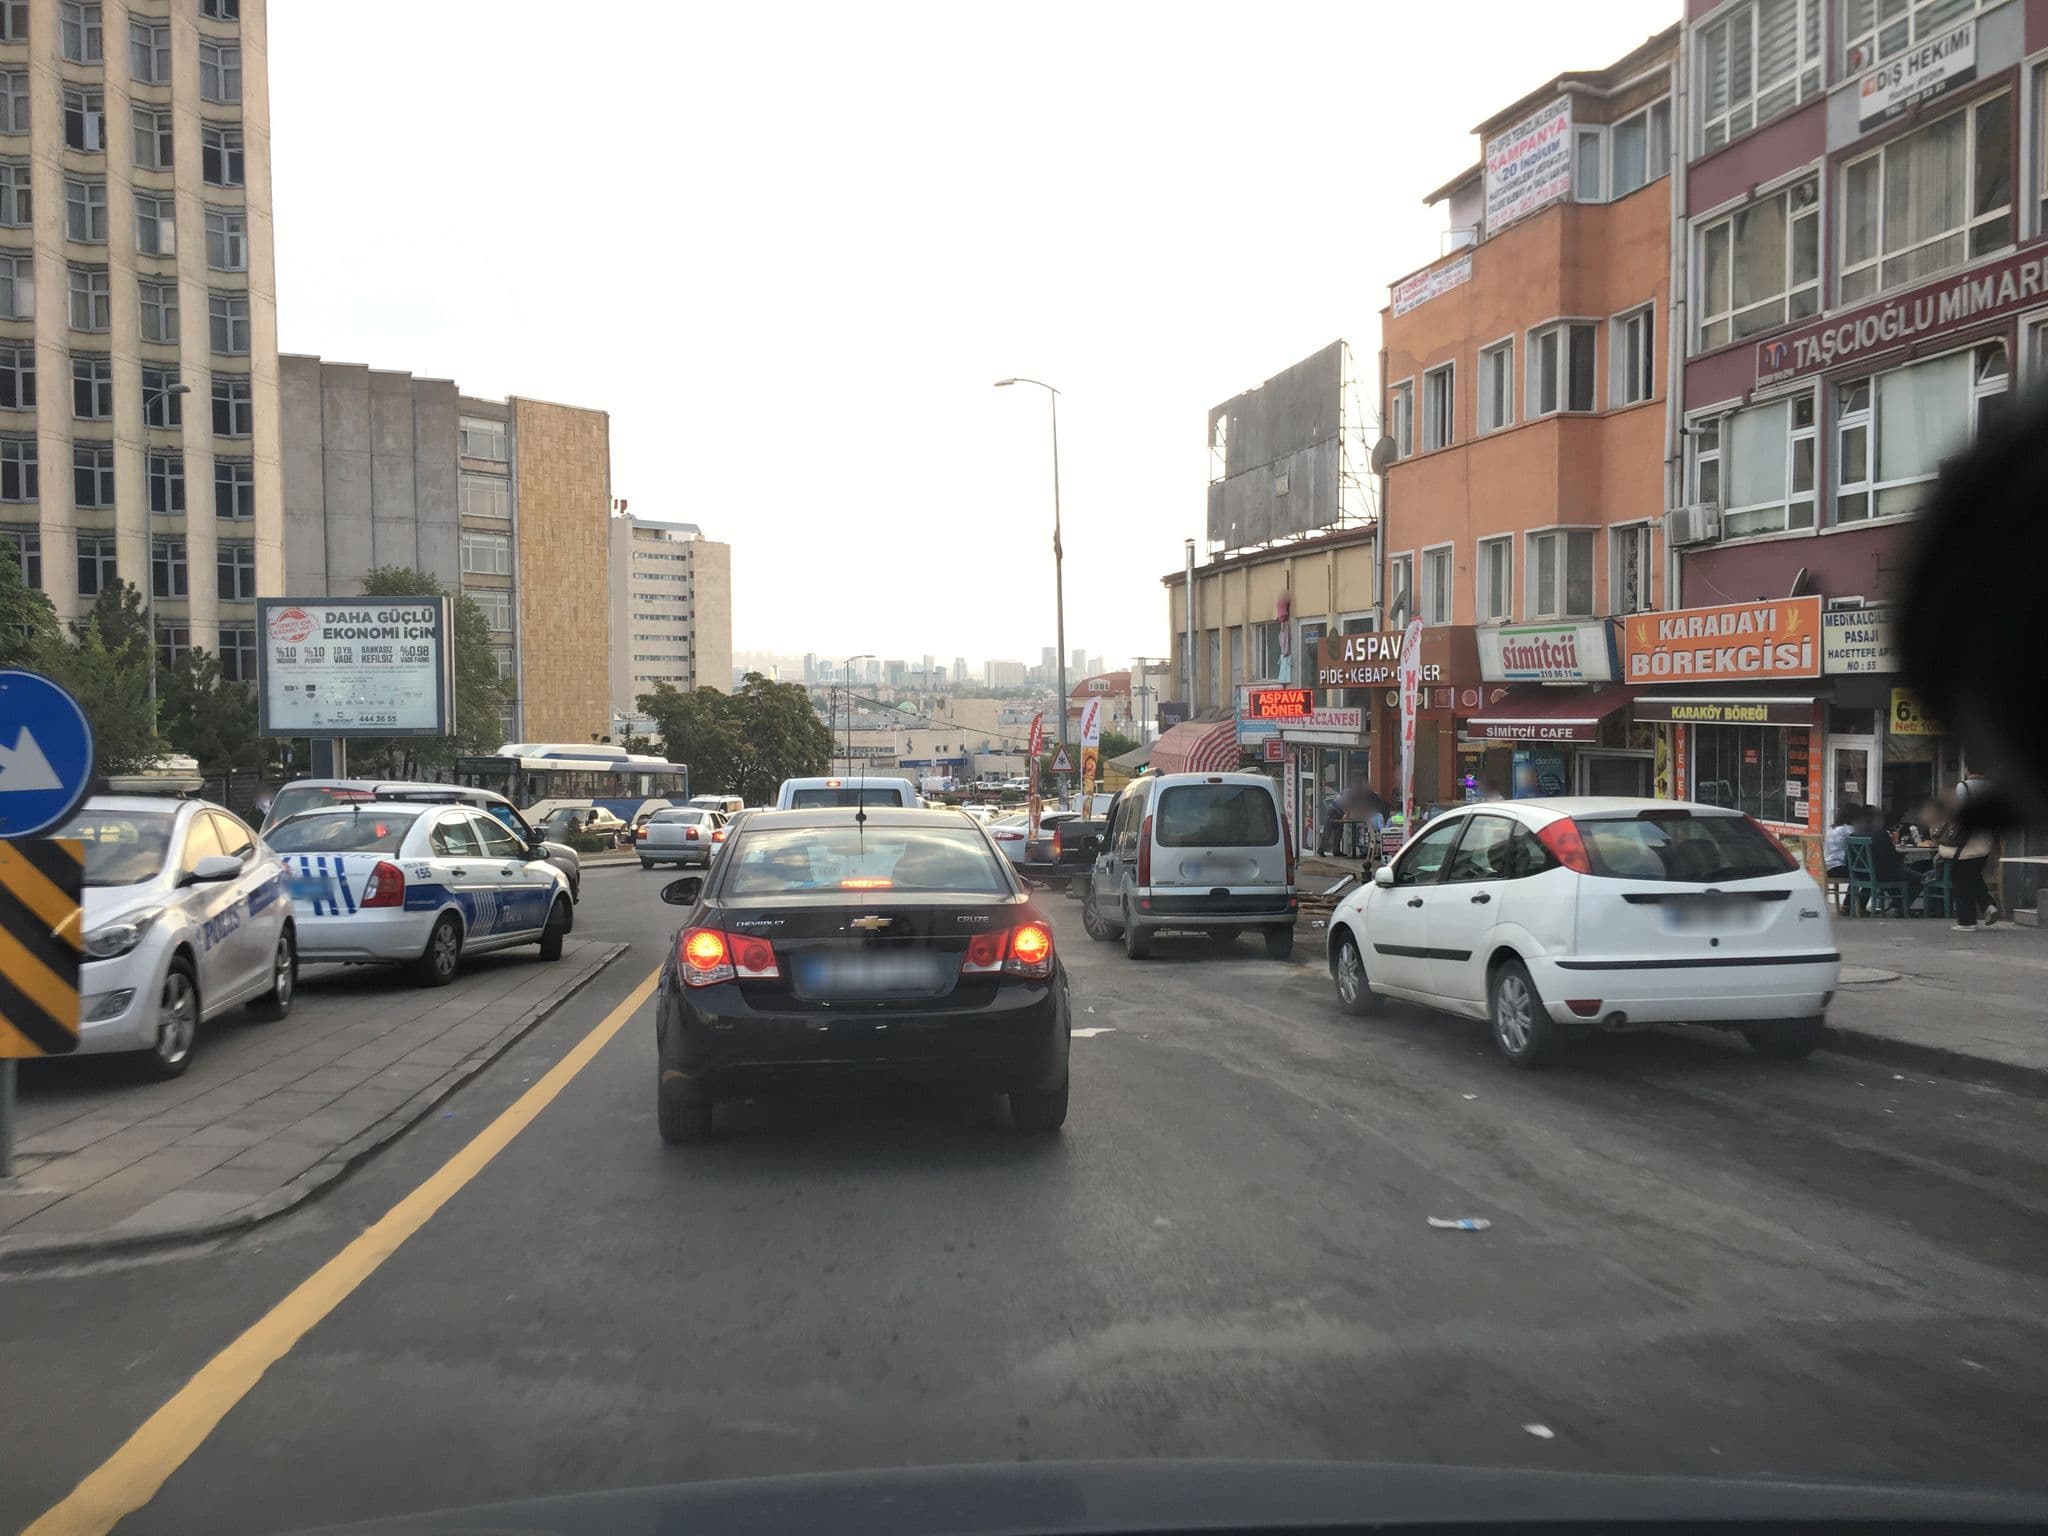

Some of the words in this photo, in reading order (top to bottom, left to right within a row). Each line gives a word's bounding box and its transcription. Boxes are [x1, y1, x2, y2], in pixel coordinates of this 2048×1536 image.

[1488, 116, 1568, 174] KAMPANYA
[1793, 296, 1935, 368] TAŞCIOĞLU
[325, 612, 373, 624] DAHA
[377, 608, 433, 625] GÜÇLÜ
[1659, 609, 1777, 640] KARADAYI
[323, 627, 399, 640] EKONOMİ
[403, 627, 437, 640] İÇİN
[1845, 630, 1879, 643] PASAJI
[276, 647, 297, 658] %10
[304, 646, 325, 658] %10
[1344, 635, 1402, 661] ASPAV
[1502, 634, 1578, 670] simitcii
[1828, 648, 1876, 659] HACETTEPE
[333, 655, 353, 663] VADE
[1632, 635, 1812, 676] BÖREKCİSİ
[1847, 661, 1859, 671] NO
[1867, 661, 1877, 670] 55
[1320, 667, 1343, 684] PİDE
[1351, 667, 1389, 683] KEBAP
[1541, 671, 1553, 679] 310
[1564, 670, 1573, 678] 11
[1259, 692, 1305, 704] ASPAVA
[1262, 703, 1303, 716] DÖNER
[1671, 705, 1722, 720] KARAKÖY
[1724, 704, 1768, 721] BÖREĞİ
[359, 715, 374, 723] 444
[376, 715, 385, 723] 36
[387, 715, 397, 723] 55
[1309, 709, 1360, 727] ECZANESİ
[1540, 728, 1573, 739] CAFE
[415, 868, 432, 880] 155
[957, 915, 989, 923] CRUZE
